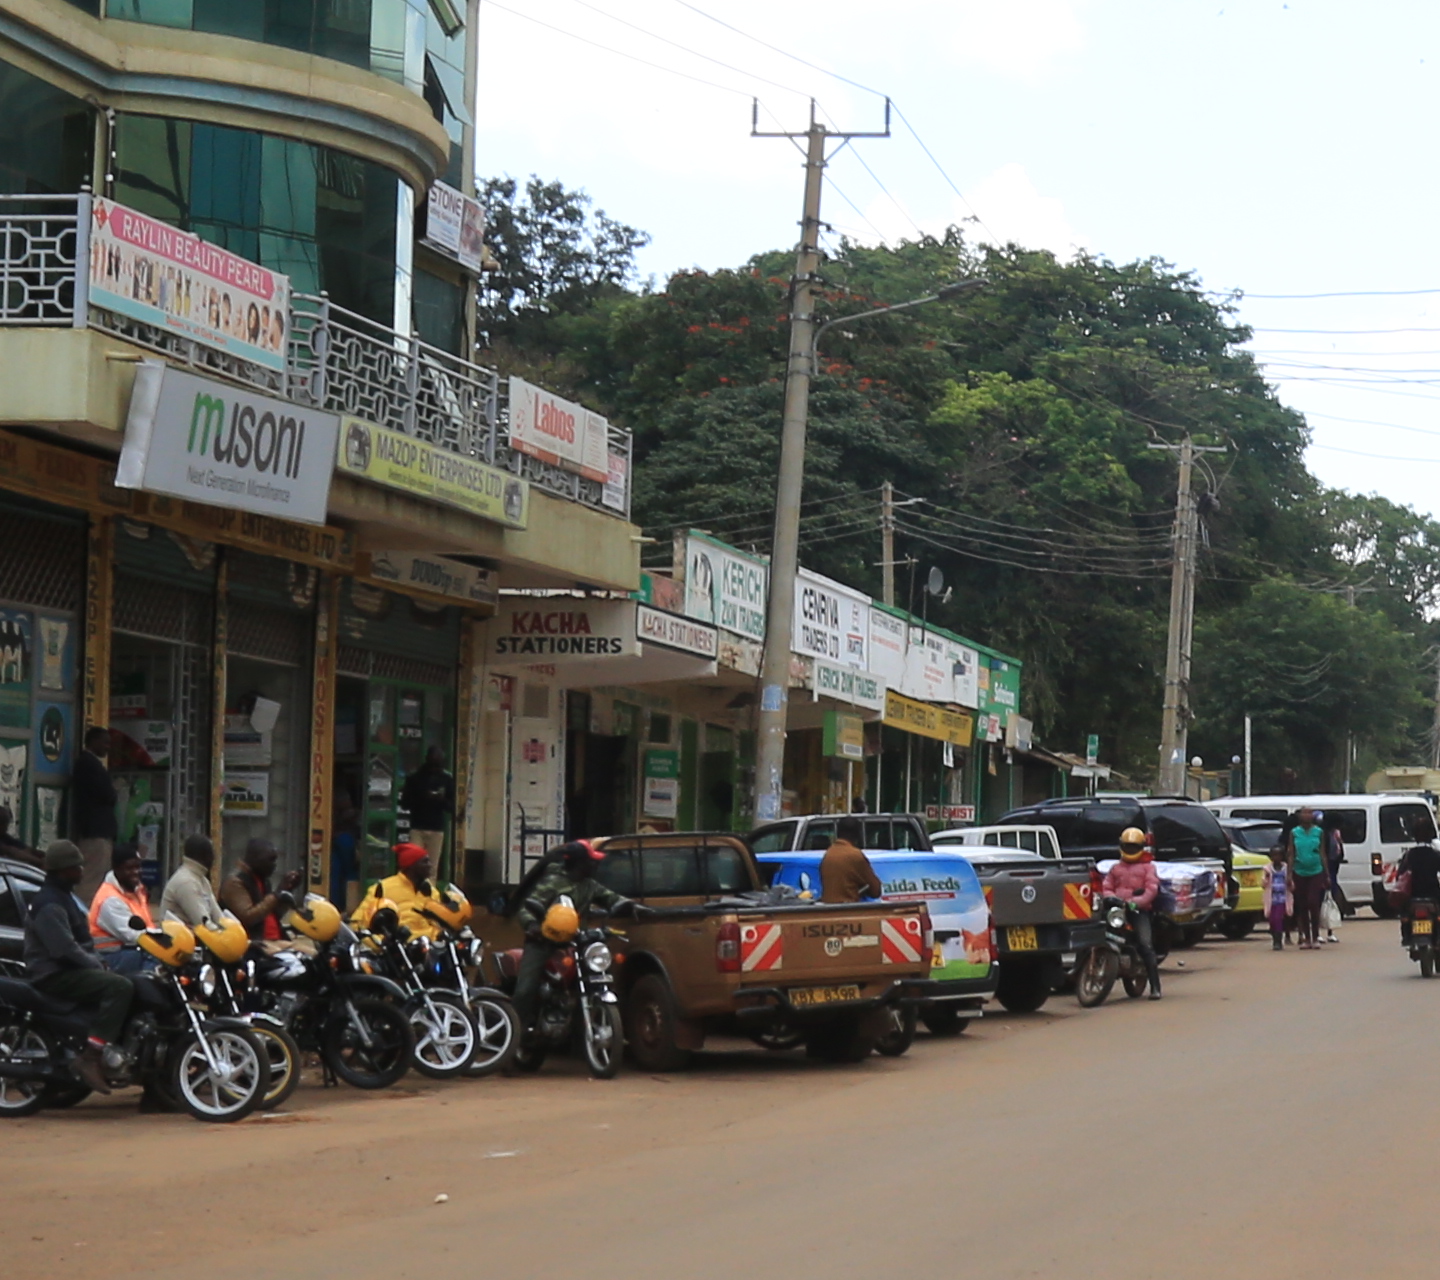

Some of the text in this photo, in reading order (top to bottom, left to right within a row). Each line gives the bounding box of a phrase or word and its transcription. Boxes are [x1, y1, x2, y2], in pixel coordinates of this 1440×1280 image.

[122, 214, 267, 295] RAYLIN BEAUTY PEARL
[187, 392, 305, 479] musoni
[377, 433, 417, 469] MAZOP
[419, 448, 484, 494] ENTERPRISES
[485, 472, 502, 499] LTD
[206, 470, 246, 494] Generation
[722, 558, 762, 606] KERICH
[512, 612, 591, 635] KACHA
[642, 610, 712, 651] KACHA STATIONERS
[496, 637, 622, 655] STATIONERS
[802, 625, 828, 656] TRADERS
[223, 789, 263, 802] araka
[921, 877, 960, 891] Feeds
[803, 923, 862, 937] ISUZU
[827, 940, 840, 949] 80
